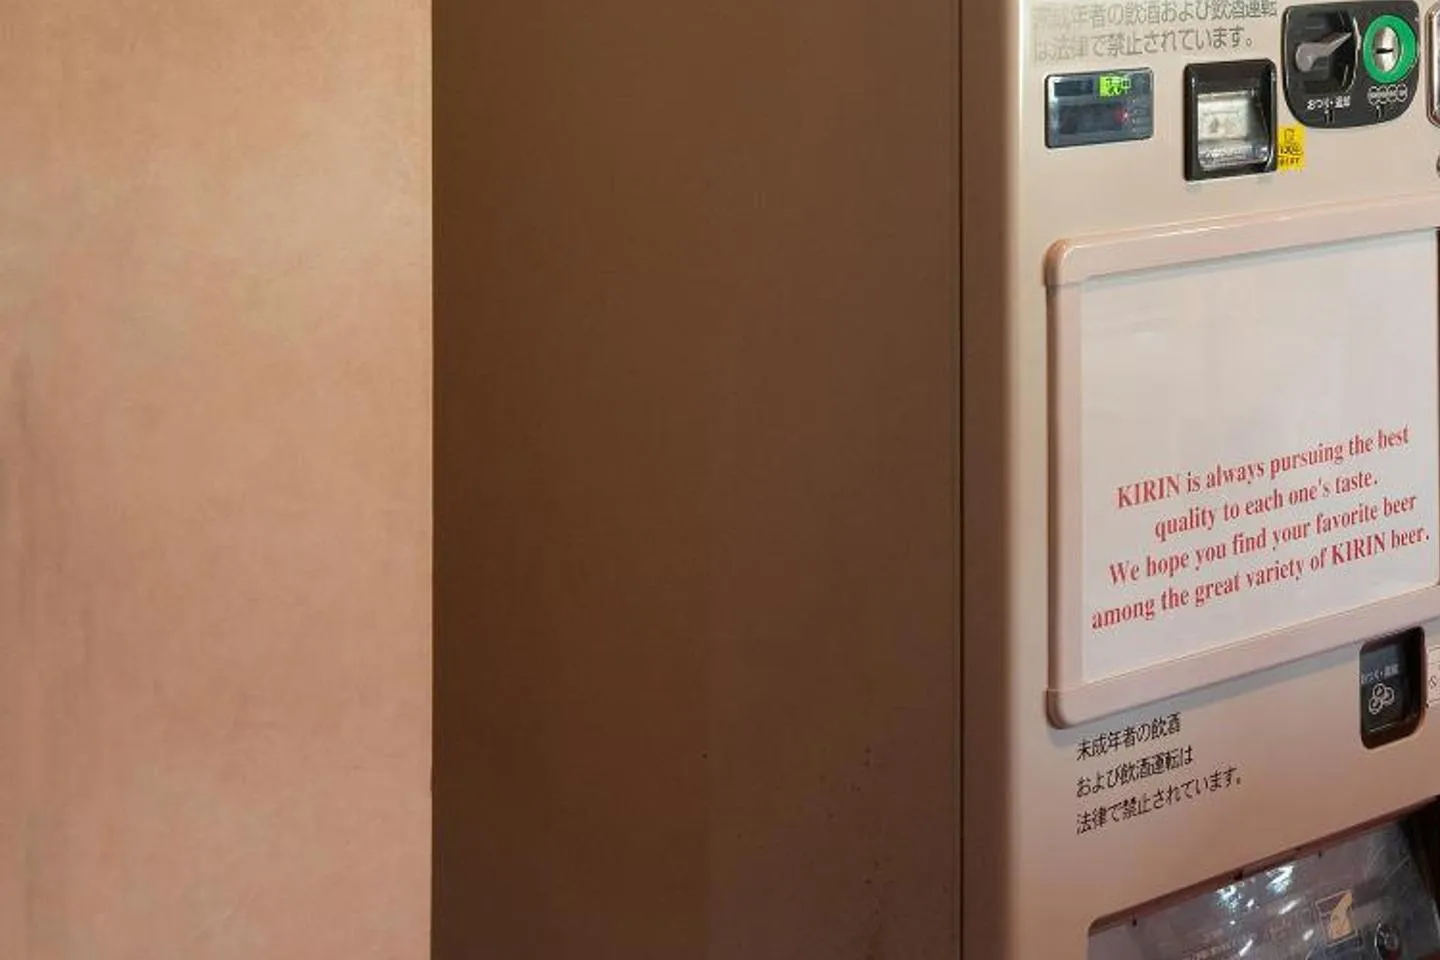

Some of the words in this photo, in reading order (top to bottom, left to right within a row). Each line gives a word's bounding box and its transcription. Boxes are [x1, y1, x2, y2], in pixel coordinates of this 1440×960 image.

[1116, 474, 1180, 510] KIRIN
[1186, 472, 1201, 493] is
[1206, 463, 1265, 488] always
[1270, 444, 1344, 479] pursuing
[1348, 434, 1374, 456] the
[1378, 424, 1409, 448] best
[1108, 561, 1140, 587] We
[1146, 552, 1190, 580] hope
[1195, 543, 1227, 571] you
[1232, 528, 1267, 556] find
[1272, 521, 1311, 553] your
[1315, 505, 1378, 535] favorite
[1383, 493, 1417, 518] beer
[1154, 506, 1218, 543] quality
[1222, 501, 1240, 520] to
[1245, 492, 1284, 518] each
[1289, 480, 1331, 506] one's
[1335, 471, 1379, 495] taste.
[1091, 601, 1155, 629] among
[1161, 585, 1190, 610] the
[1194, 572, 1241, 608] great
[1245, 556, 1305, 590] variety
[1309, 545, 1329, 571] of
[1331, 532, 1387, 566] KIRIN
[1390, 524, 1430, 550] beer.
[1076, 745, 1193, 797] および飲酒運転は
[1077, 712, 1182, 762] 未成年者の飲酒
[1076, 766, 1242, 834] 法律で禁止されています。
